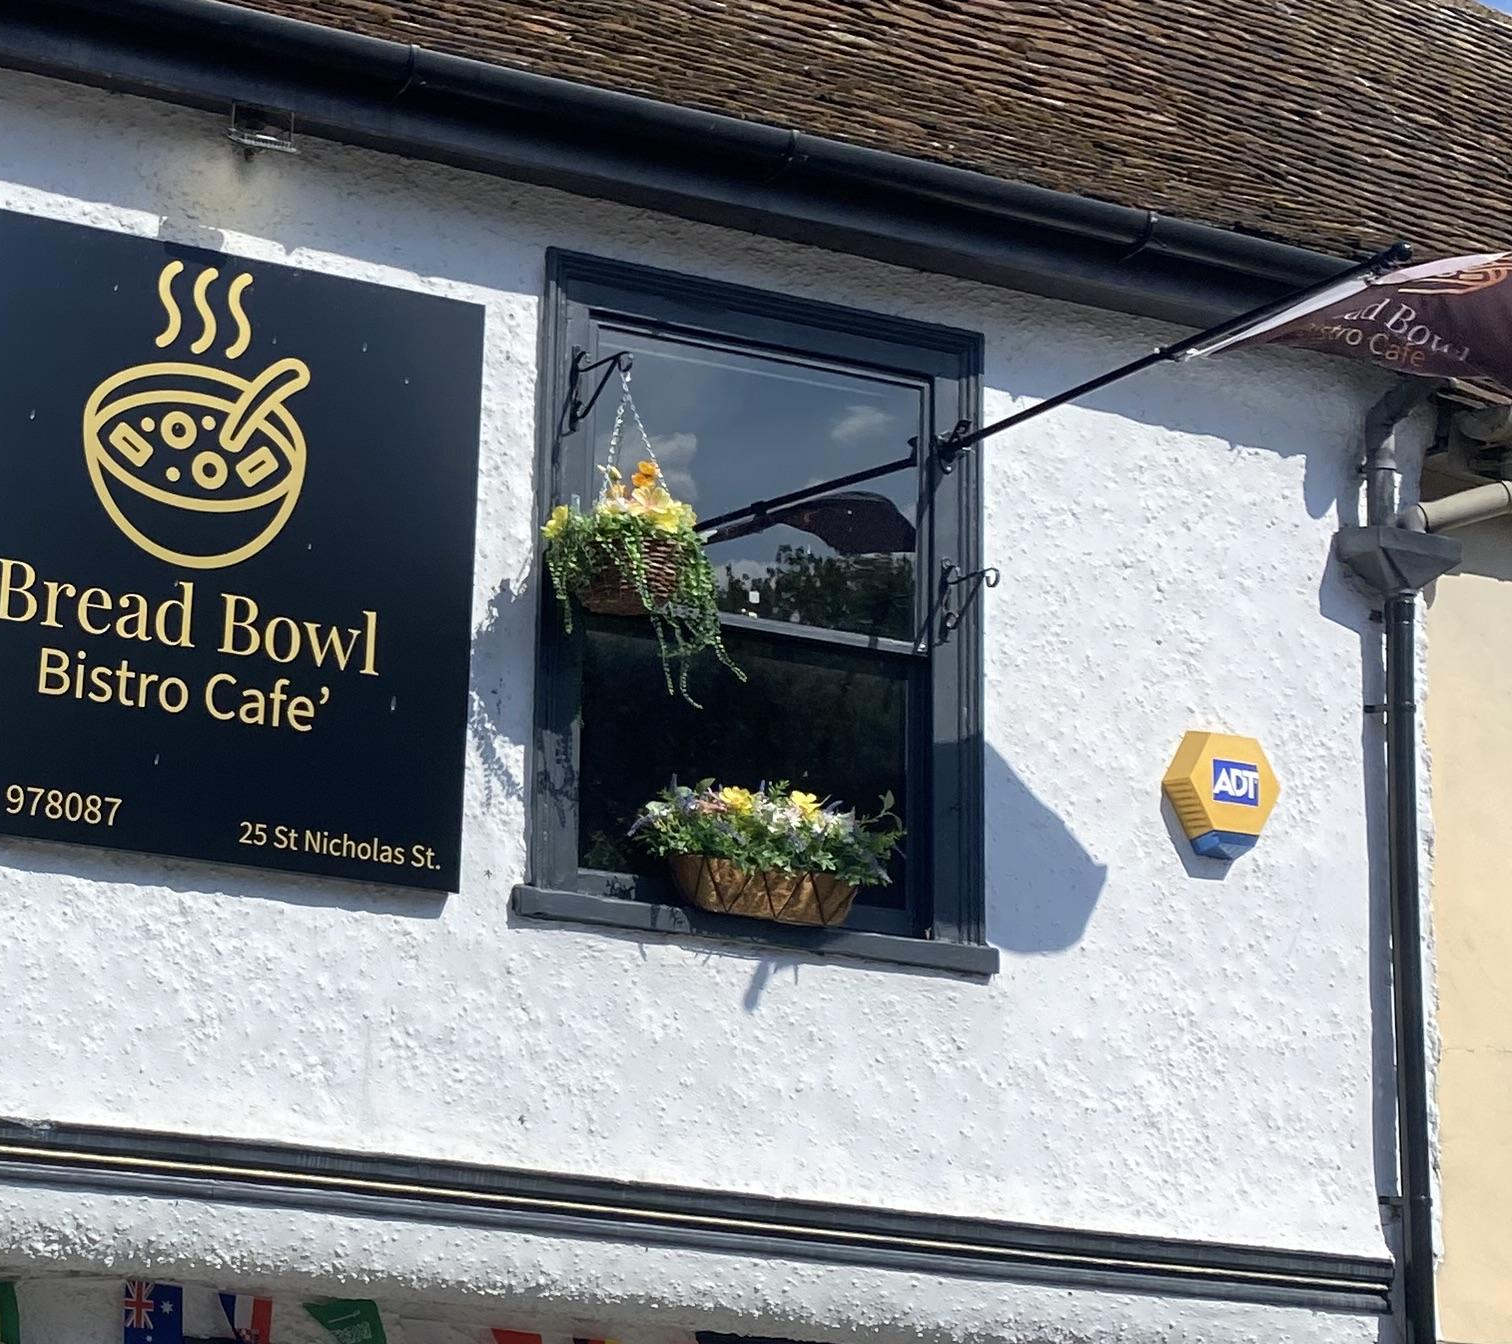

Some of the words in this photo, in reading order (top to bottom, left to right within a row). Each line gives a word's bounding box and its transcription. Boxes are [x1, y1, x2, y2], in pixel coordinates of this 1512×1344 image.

[216, 593, 381, 677] Bowl
[36, 646, 189, 714] Bistro
[5, 782, 124, 828] 978087
[1213, 767, 1259, 800] ADT
[238, 820, 268, 847] 25
[273, 825, 300, 851] St
[304, 830, 407, 866] Nicholas
[410, 843, 442, 871] St.
